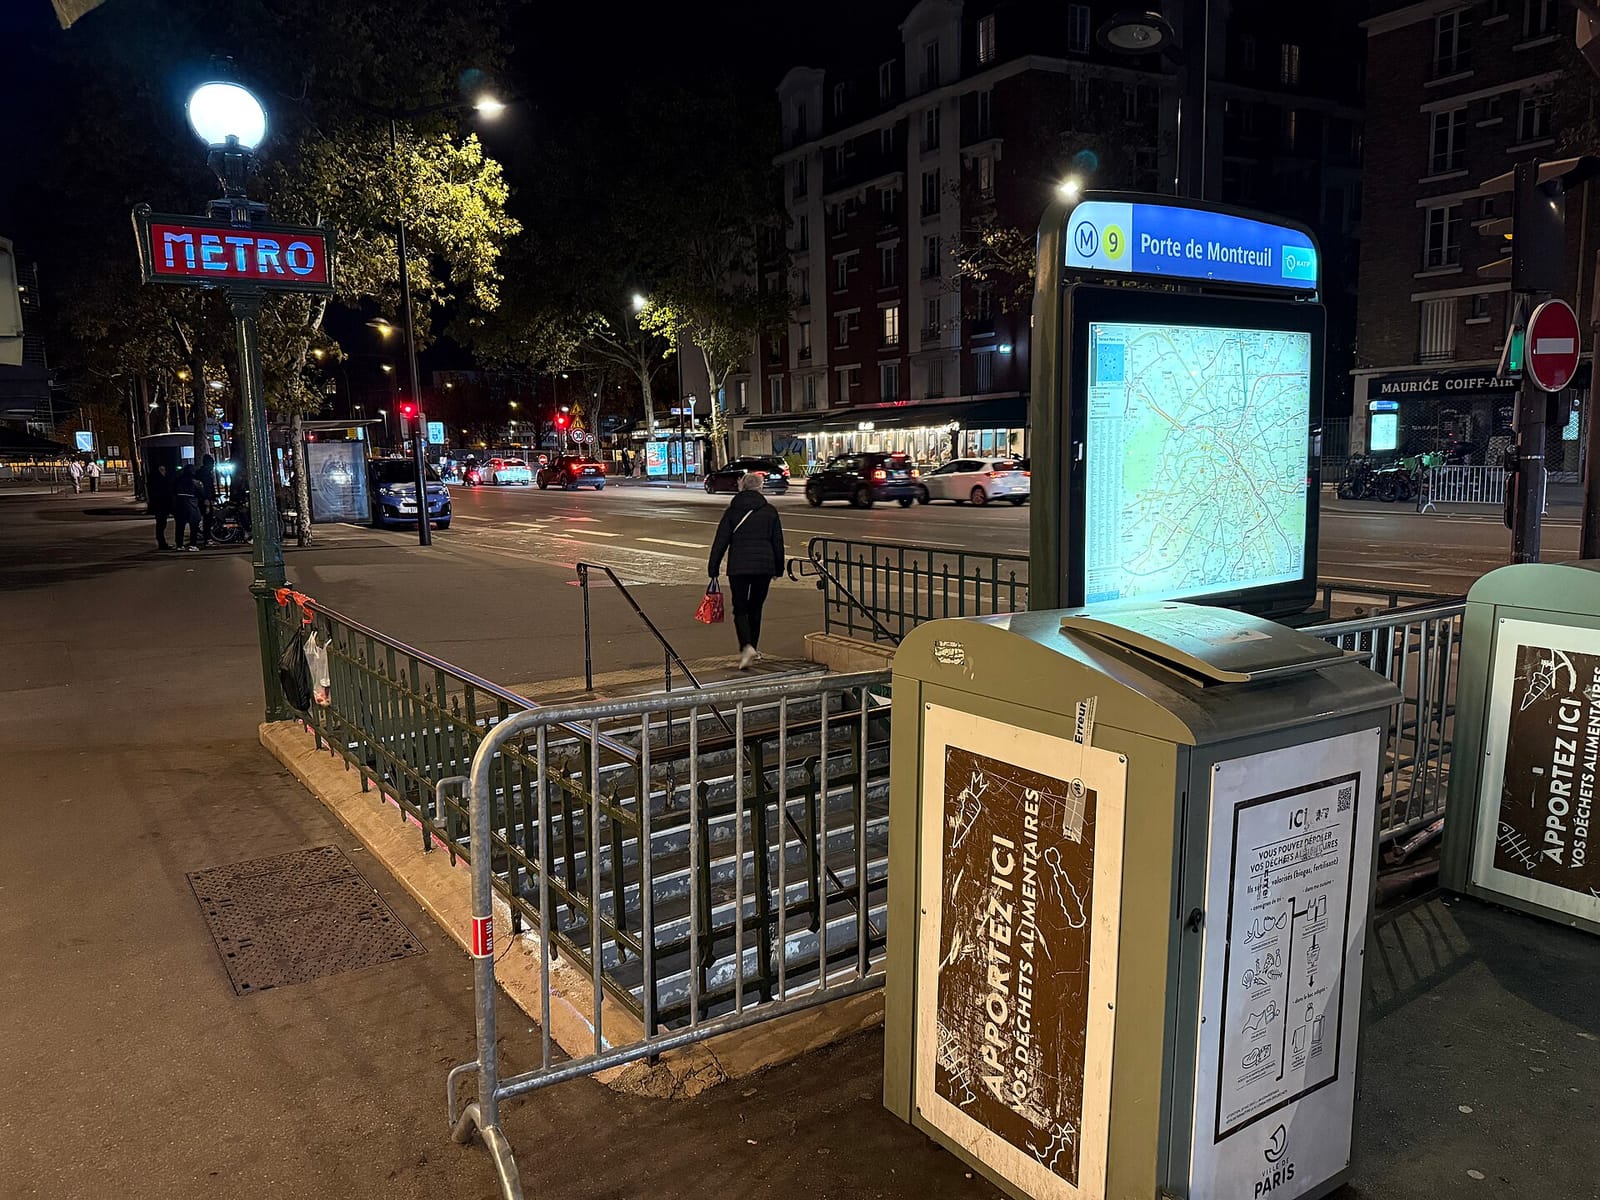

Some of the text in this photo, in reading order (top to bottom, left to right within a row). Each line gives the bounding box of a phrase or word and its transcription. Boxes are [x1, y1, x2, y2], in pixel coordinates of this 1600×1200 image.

[164, 231, 315, 275] METRO
[1108, 232, 1118, 253] 9
[1141, 233, 1181, 258] Porte
[1185, 237, 1203, 259] de
[1207, 241, 1272, 268] Montreuil
[1381, 380, 1440, 394] MAURICE
[1074, 702, 1088, 745] Erreur
[1543, 698, 1582, 865] APPORTEZ ICI
[1574, 772, 1595, 838] DÉCHETS
[1250, 838, 1339, 873] VOS DÉCHETS ALTIRES
[1258, 847, 1278, 860] VOUS
[1278, 839, 1304, 854] POUVEZ
[1570, 839, 1586, 869] VOS
[1012, 787, 1040, 1111] VOS DÉCHETS ALIMENTAIRES
[982, 834, 1016, 1103] APPORTEZ ICI
[1254, 1163, 1295, 1200] PARIS
[1262, 1162, 1280, 1177] VILLE
